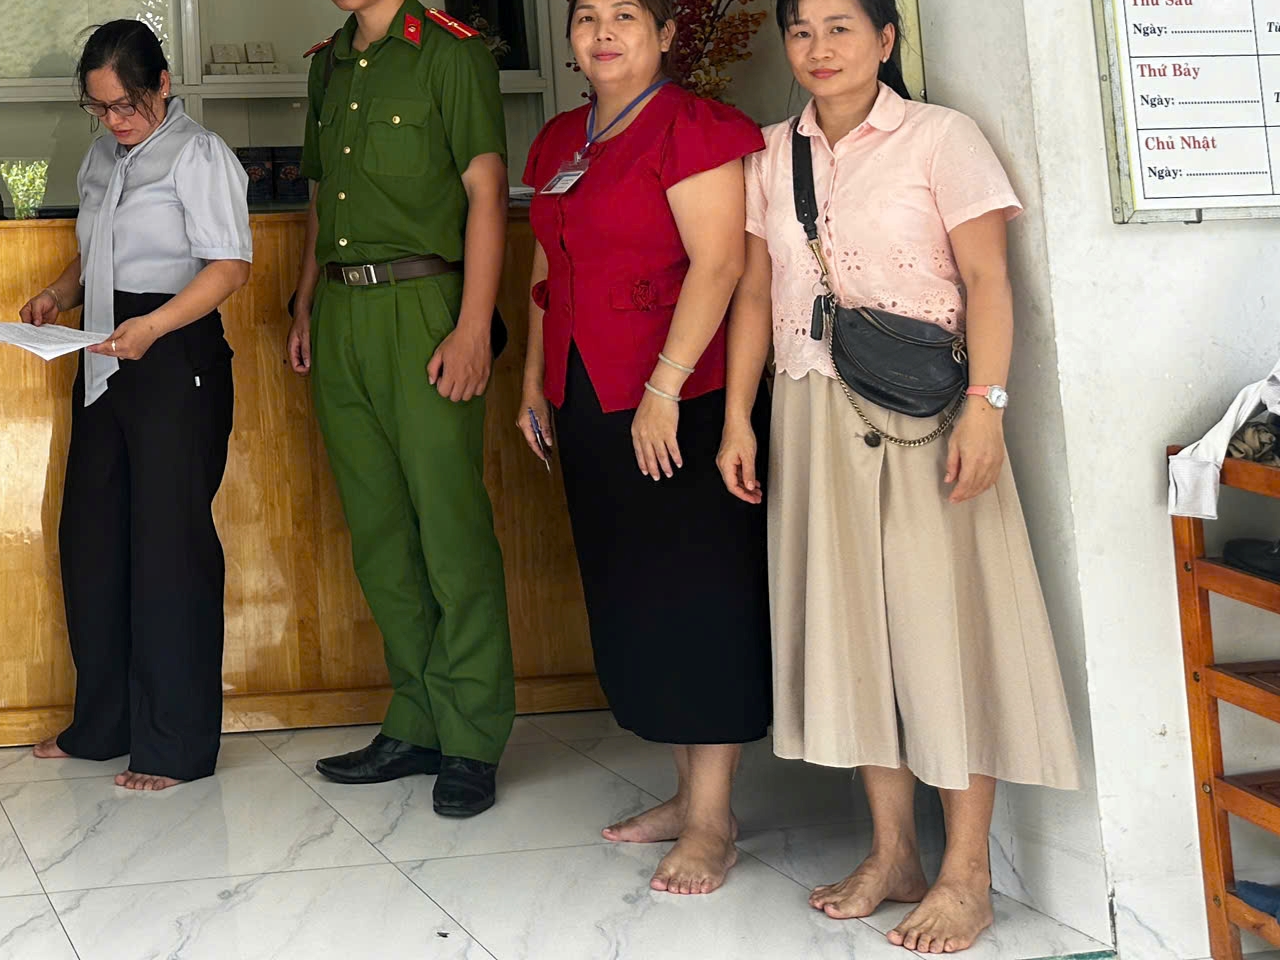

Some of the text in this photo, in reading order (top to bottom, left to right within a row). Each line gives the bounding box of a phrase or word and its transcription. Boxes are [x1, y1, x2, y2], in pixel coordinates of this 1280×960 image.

[1133, 24, 1167, 37] Ngày:
[1137, 63, 1200, 80] Thứ Bảy
[1140, 94, 1174, 108] Ngày:
[1145, 135, 1217, 151] Chủ Nhật
[1148, 165, 1182, 179] Ngày:
